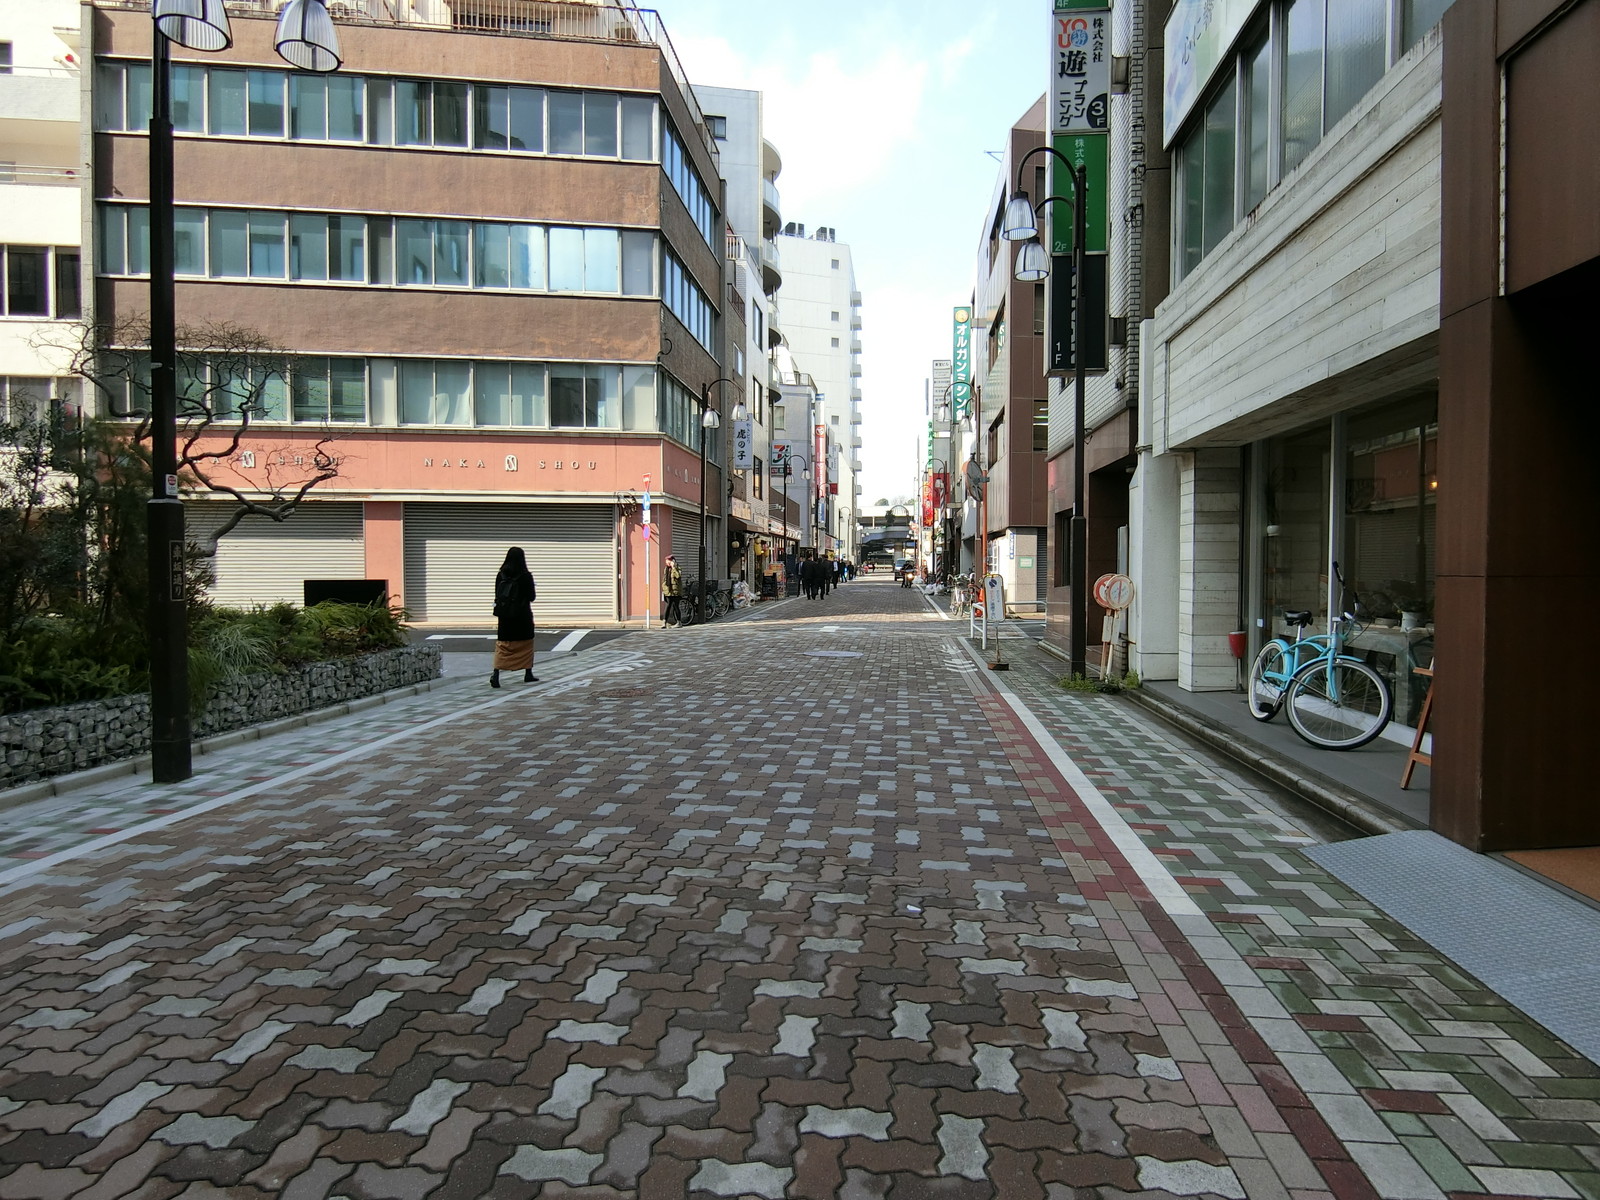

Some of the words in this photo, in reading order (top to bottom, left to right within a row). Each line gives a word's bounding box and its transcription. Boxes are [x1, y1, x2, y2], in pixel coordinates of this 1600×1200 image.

[1093, 17, 1104, 63] 株式会社
[1091, 101, 1106, 127] 3F
[1055, 241, 1067, 252] 2F
[1055, 341, 1062, 365] 1F
[737, 429, 746, 461] 虎の子
[424, 458, 485, 469] NAKA
[539, 460, 597, 470] SHOU
